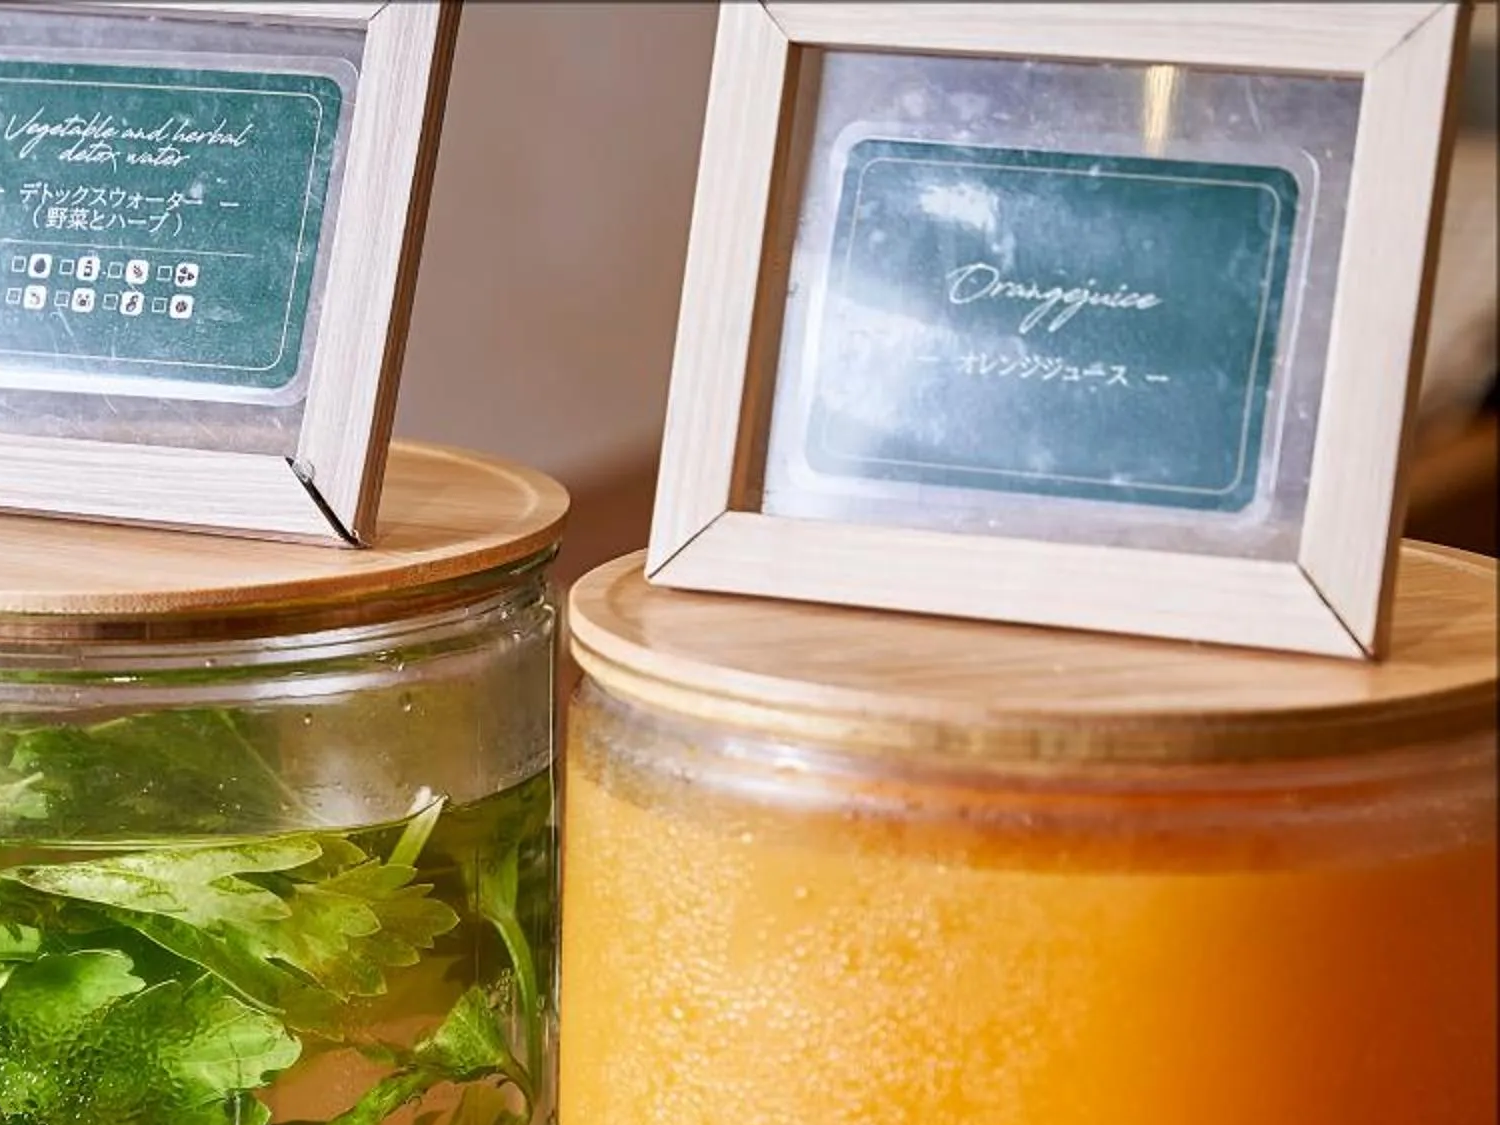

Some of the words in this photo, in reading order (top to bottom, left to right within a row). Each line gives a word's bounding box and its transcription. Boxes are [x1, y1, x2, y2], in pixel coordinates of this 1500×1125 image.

[4, 106, 119, 160] Vegetable
[121, 117, 168, 143] and
[172, 117, 255, 148] herbal
[58, 139, 121, 173] detox
[126, 145, 191, 167] water
[19, 181, 204, 211] デトックスウォーター
[944, 261, 1163, 335] Orangejuice
[958, 351, 1129, 387] オレンジジュース
